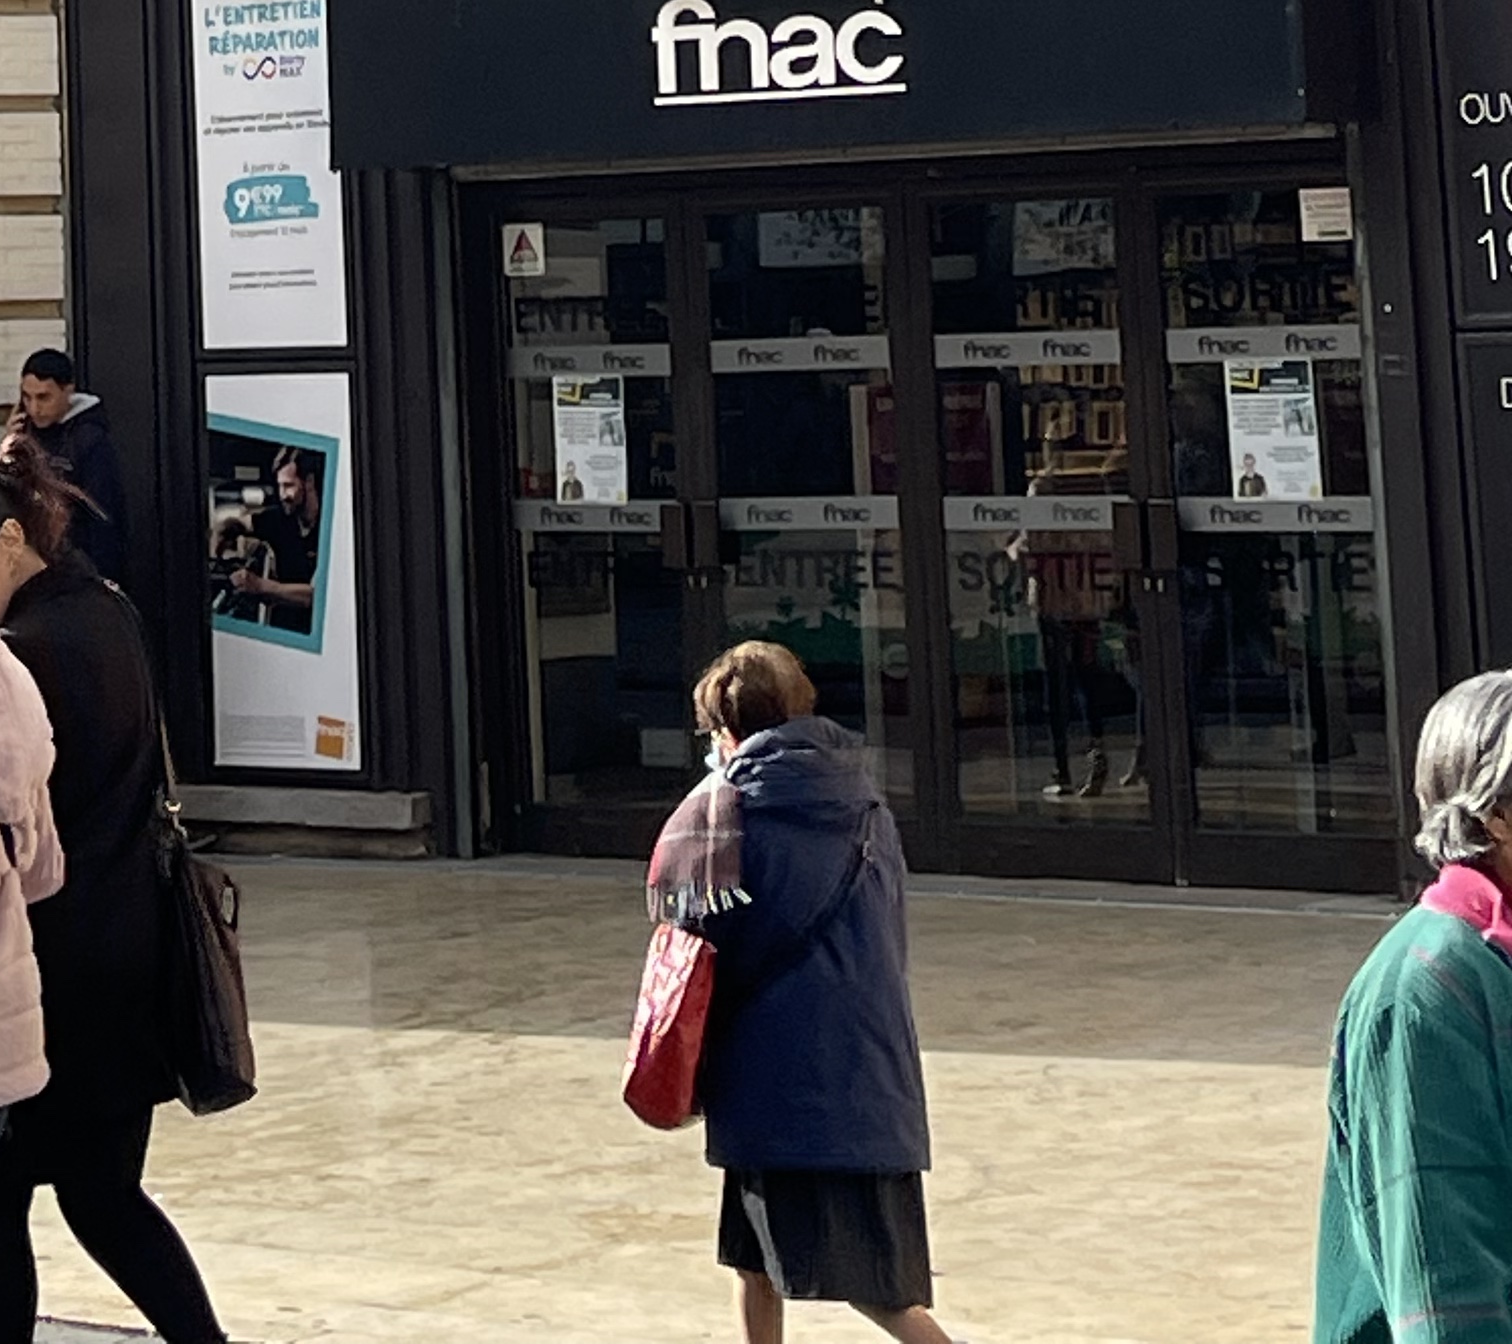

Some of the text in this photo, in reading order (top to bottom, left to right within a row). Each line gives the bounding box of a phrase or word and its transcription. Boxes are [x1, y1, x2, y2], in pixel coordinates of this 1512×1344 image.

[208, 26, 320, 56] RÉPARATION
[1477, 228, 1512, 281] 1
[737, 343, 861, 365] fnac fnac
[963, 337, 1092, 359] fnac fnac
[1198, 333, 1339, 355] fnac fnac
[533, 351, 645, 370] fnac fnac
[540, 506, 652, 525] fnac fnac
[746, 502, 871, 523] fnac fnac
[972, 502, 1100, 522] fnac fnac
[1209, 504, 1351, 523] fnac fnac
